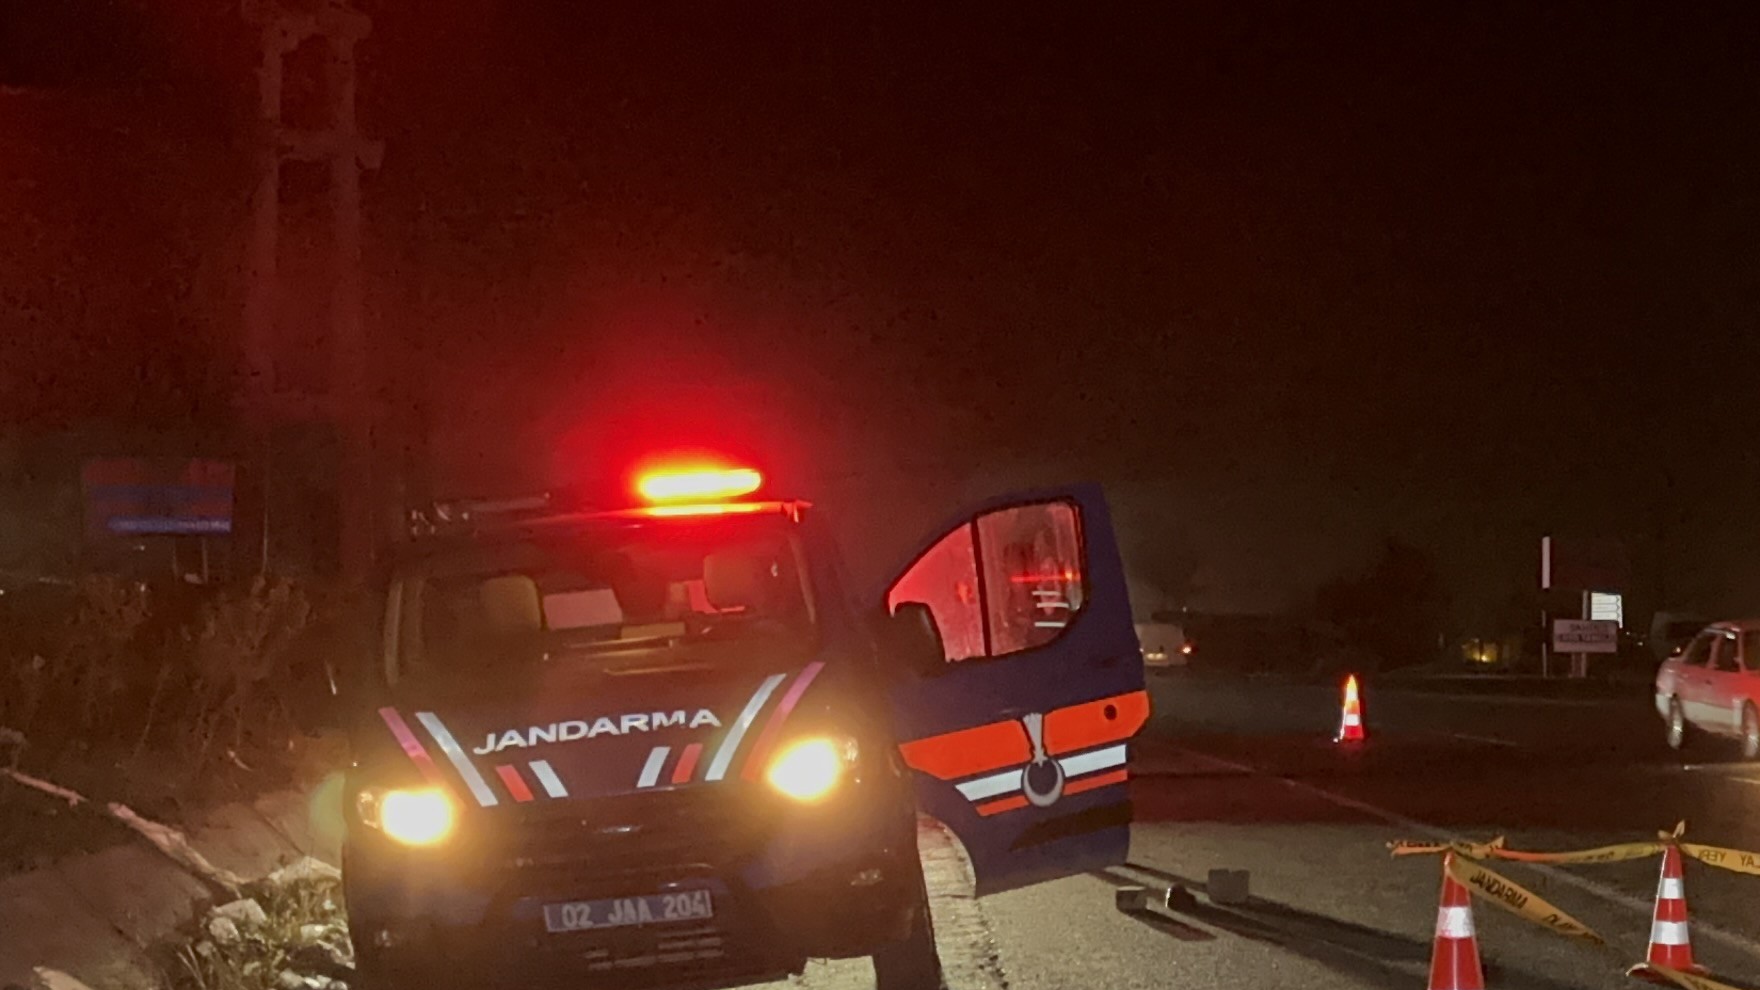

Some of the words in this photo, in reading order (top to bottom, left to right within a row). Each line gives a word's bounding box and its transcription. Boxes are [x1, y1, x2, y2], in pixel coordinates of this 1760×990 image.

[473, 709, 721, 754] JANDARMA
[562, 903, 593, 928] 02
[608, 897, 652, 923] JAA
[663, 892, 705, 918] 204
